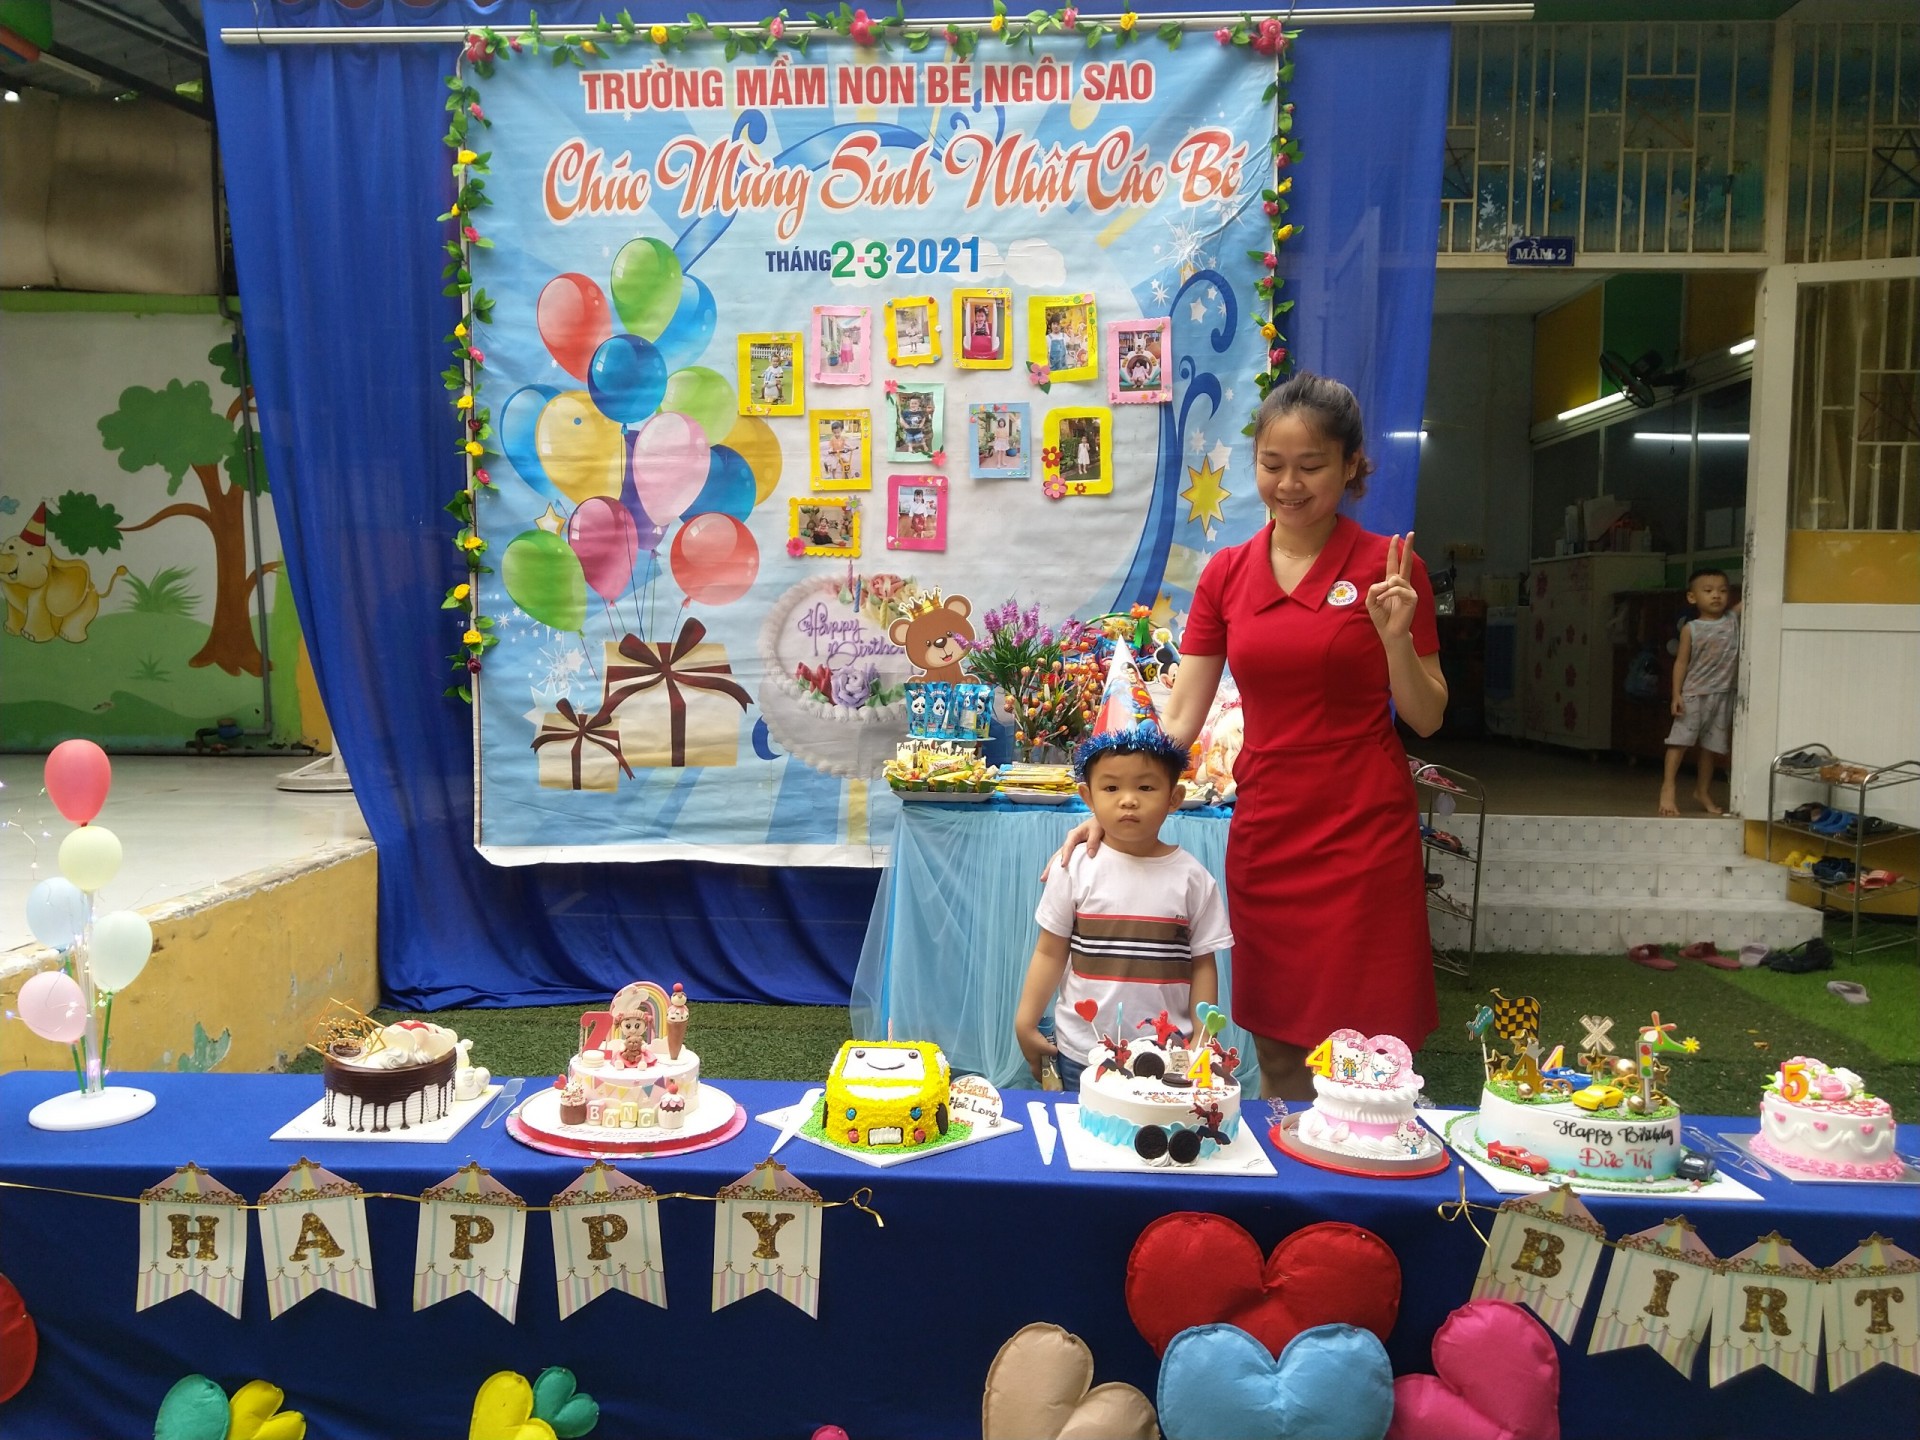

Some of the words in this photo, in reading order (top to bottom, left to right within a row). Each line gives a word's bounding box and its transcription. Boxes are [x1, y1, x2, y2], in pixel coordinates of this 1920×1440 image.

[582, 62, 723, 110] TRƯỜNG
[736, 55, 826, 106] MẦM
[839, 65, 914, 105] NON
[928, 56, 971, 103] BÉ
[984, 56, 1070, 103] NGÔI
[1084, 62, 1153, 101] SAO
[546, 141, 649, 221] Chúc
[658, 138, 811, 240] Mừng
[821, 135, 934, 210] Sinh
[945, 133, 1084, 213] Nhật
[1086, 131, 1164, 212] Các
[1171, 131, 1248, 203] Bé
[765, 246, 831, 272] THÁNG
[1557, 248, 1567, 260] 2
[1186, 1048, 1213, 1089] 4
[1305, 1039, 1334, 1078] 4
[1780, 1061, 1809, 1102] 5
[1553, 1120, 1613, 1146] Happy
